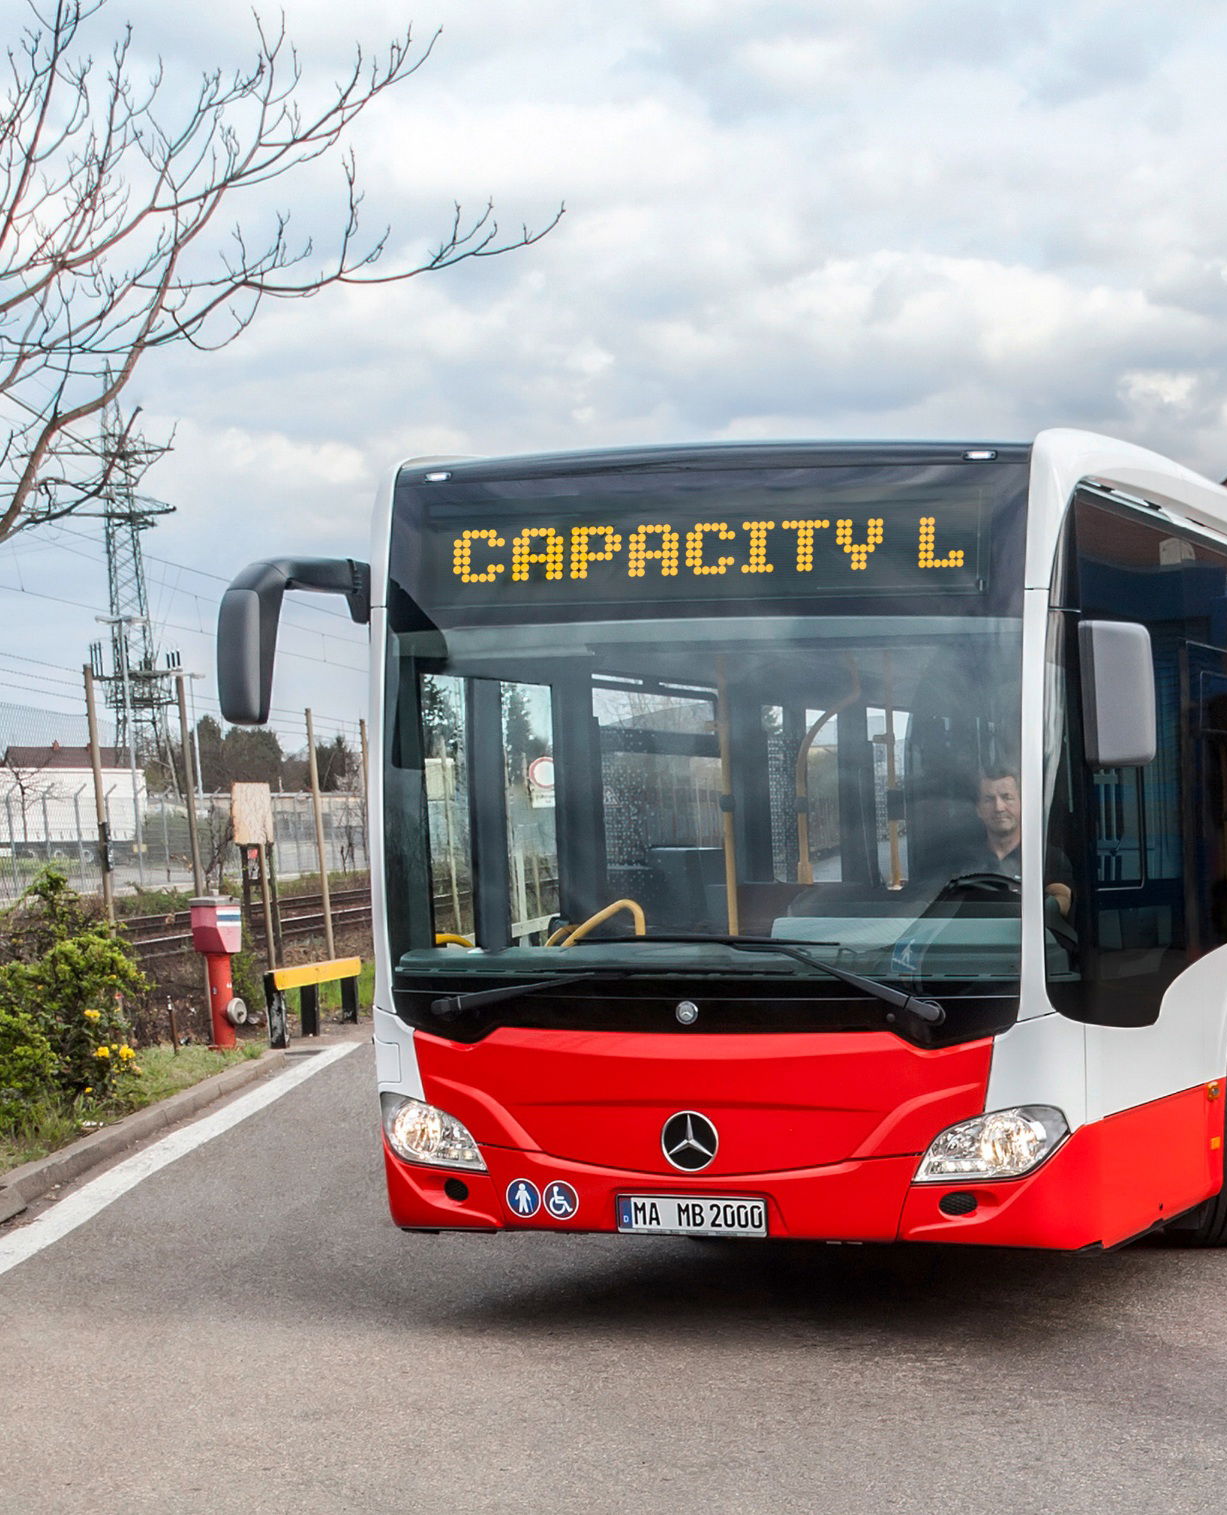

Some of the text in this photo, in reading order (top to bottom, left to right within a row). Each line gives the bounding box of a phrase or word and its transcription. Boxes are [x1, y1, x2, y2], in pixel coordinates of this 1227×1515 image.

[453, 517, 964, 582] CAPACITY L
[633, 1202, 661, 1226] MA
[676, 1203, 705, 1227] MB
[709, 1204, 763, 1229] 2000
